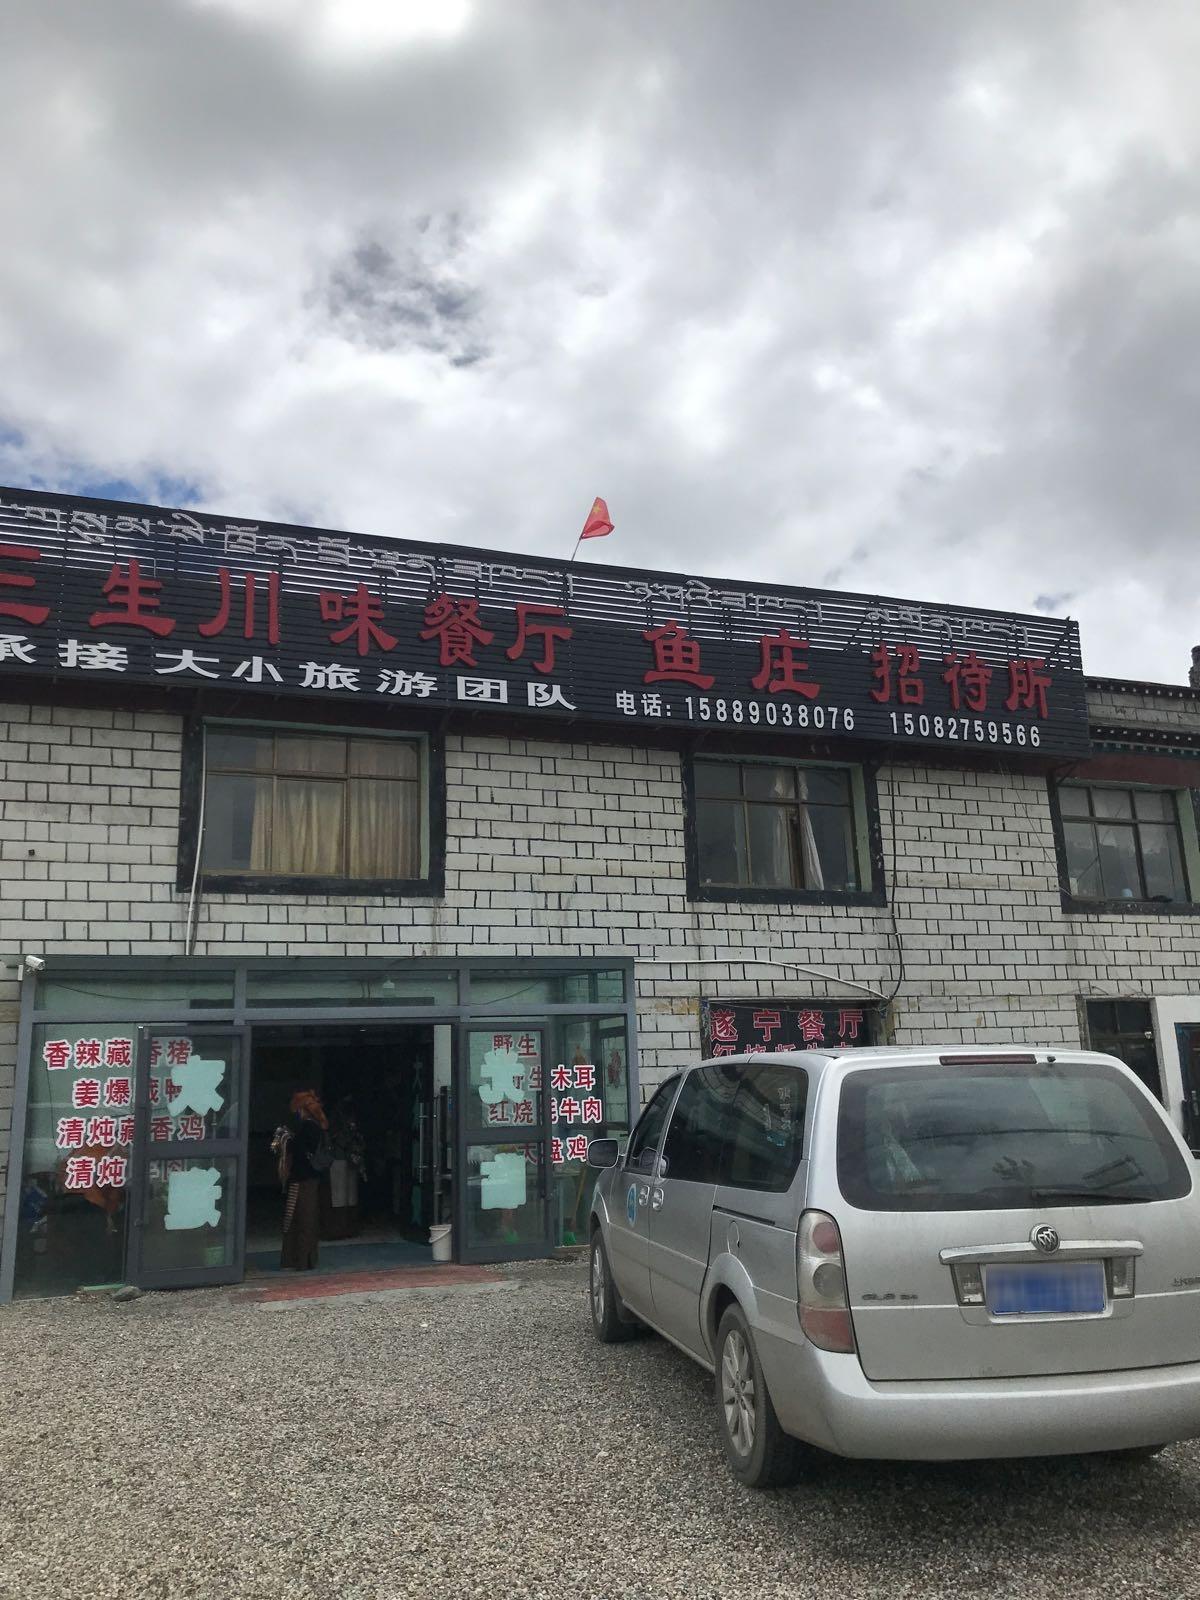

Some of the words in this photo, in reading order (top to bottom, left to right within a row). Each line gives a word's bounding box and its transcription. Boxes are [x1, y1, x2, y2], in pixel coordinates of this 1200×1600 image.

[0, 634, 577, 710] 承接大小旅游团队
[642, 619, 820, 699] 鱼庄
[870, 642, 1053, 719] 招待所
[685, 697, 855, 731] 15889038076
[889, 711, 1040, 747] 15082759566
[710, 1008, 863, 1042] 遂宁餐厅
